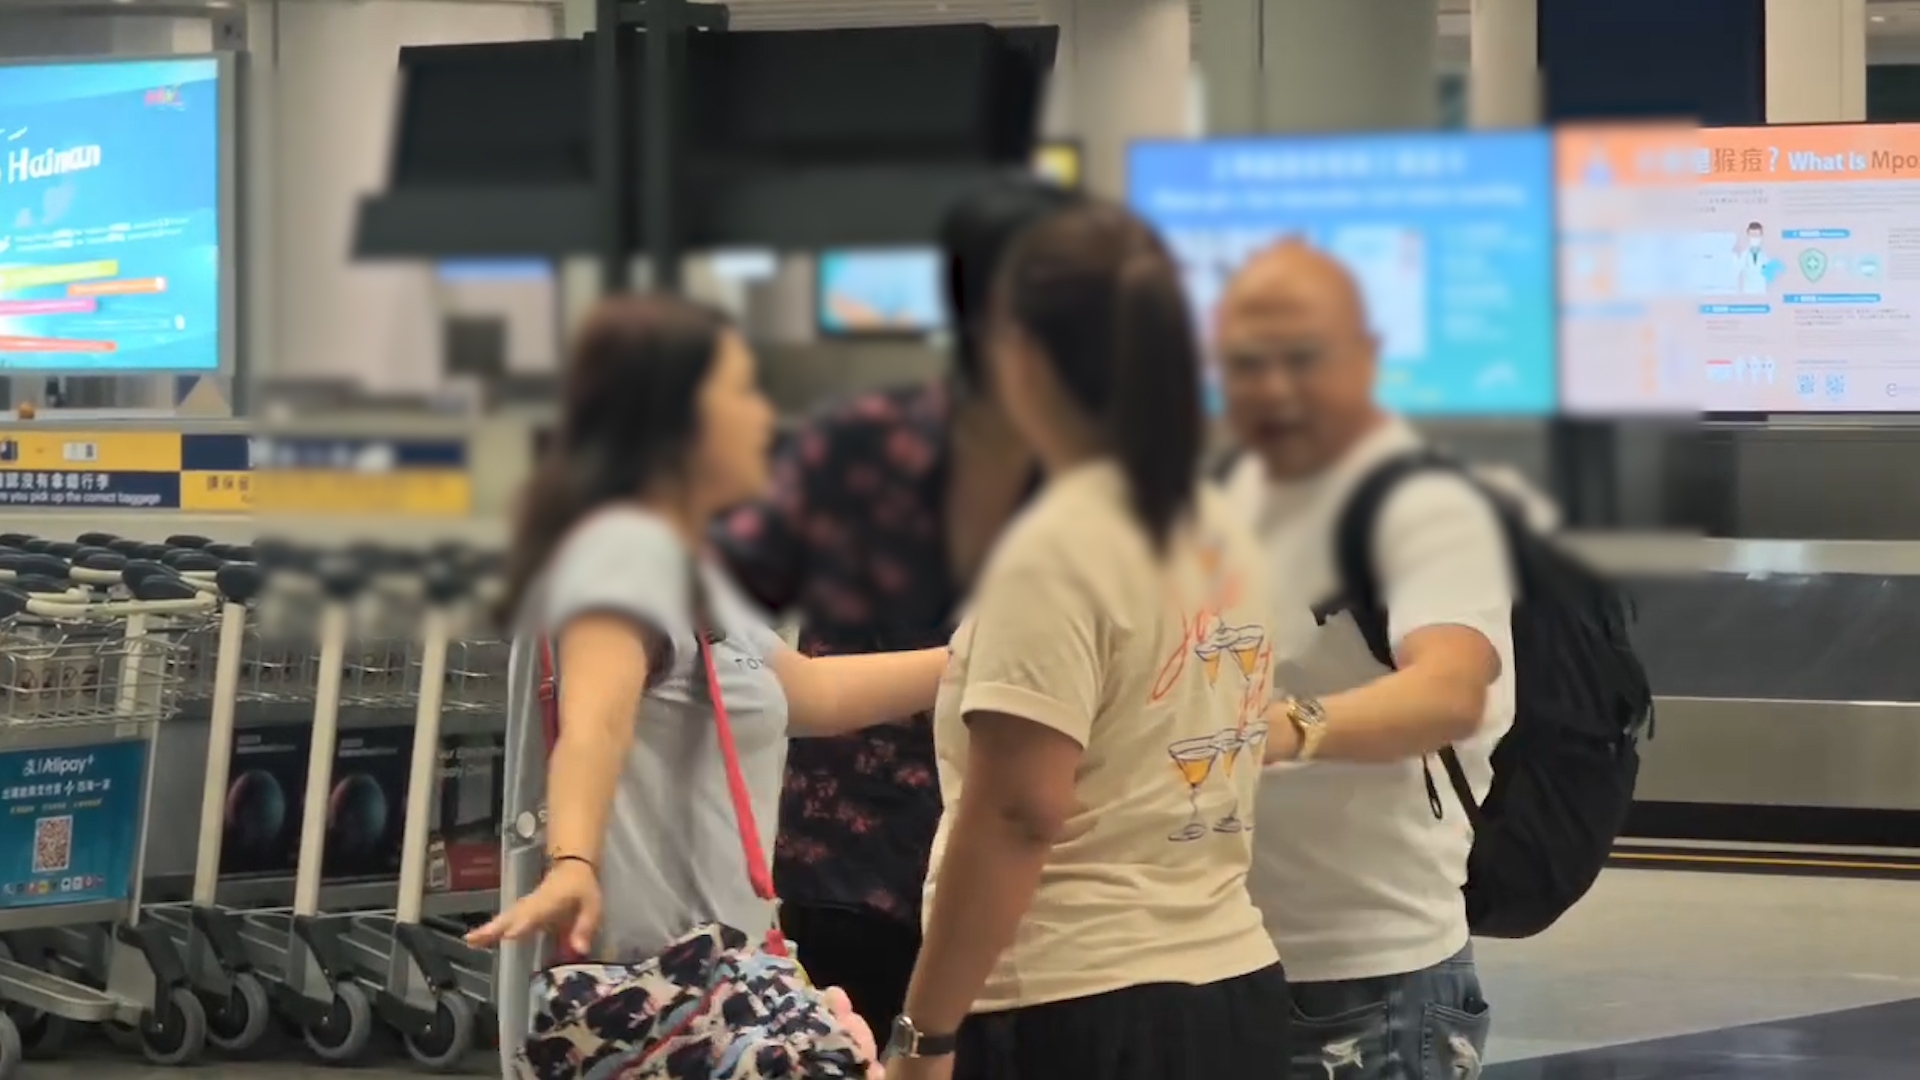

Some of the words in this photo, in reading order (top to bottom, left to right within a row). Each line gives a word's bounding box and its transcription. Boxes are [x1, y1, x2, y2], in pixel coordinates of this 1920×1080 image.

[8, 145, 101, 183] Hainan
[1788, 150, 1844, 172] What
[1849, 151, 1866, 171] is
[1871, 150, 1920, 174] Mpo
[11, 492, 28, 503] you
[30, 491, 48, 503] pick
[51, 493, 64, 504] up
[66, 491, 81, 502] the
[83, 492, 116, 502] correct
[118, 491, 161, 505] baggage
